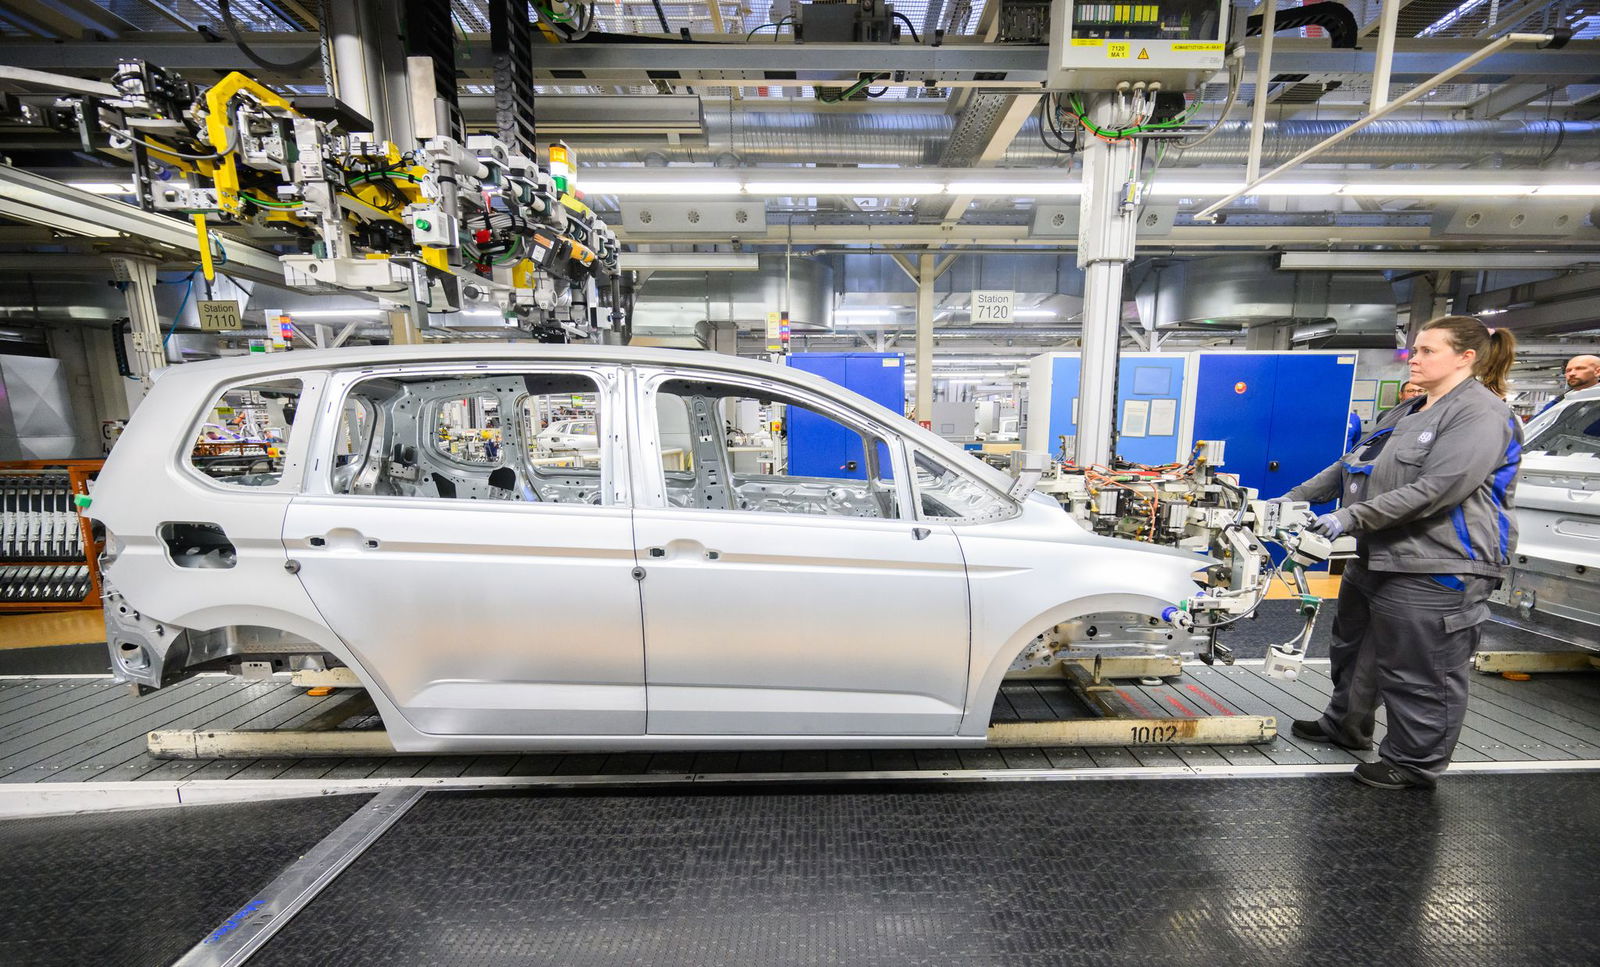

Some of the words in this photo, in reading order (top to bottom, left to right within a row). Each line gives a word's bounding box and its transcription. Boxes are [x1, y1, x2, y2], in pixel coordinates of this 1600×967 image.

[978, 294, 1009, 303] Station
[203, 304, 234, 313] Station
[978, 305, 1008, 319] 7120
[205, 314, 236, 327] 7110
[1131, 726, 1177, 744] 1002
